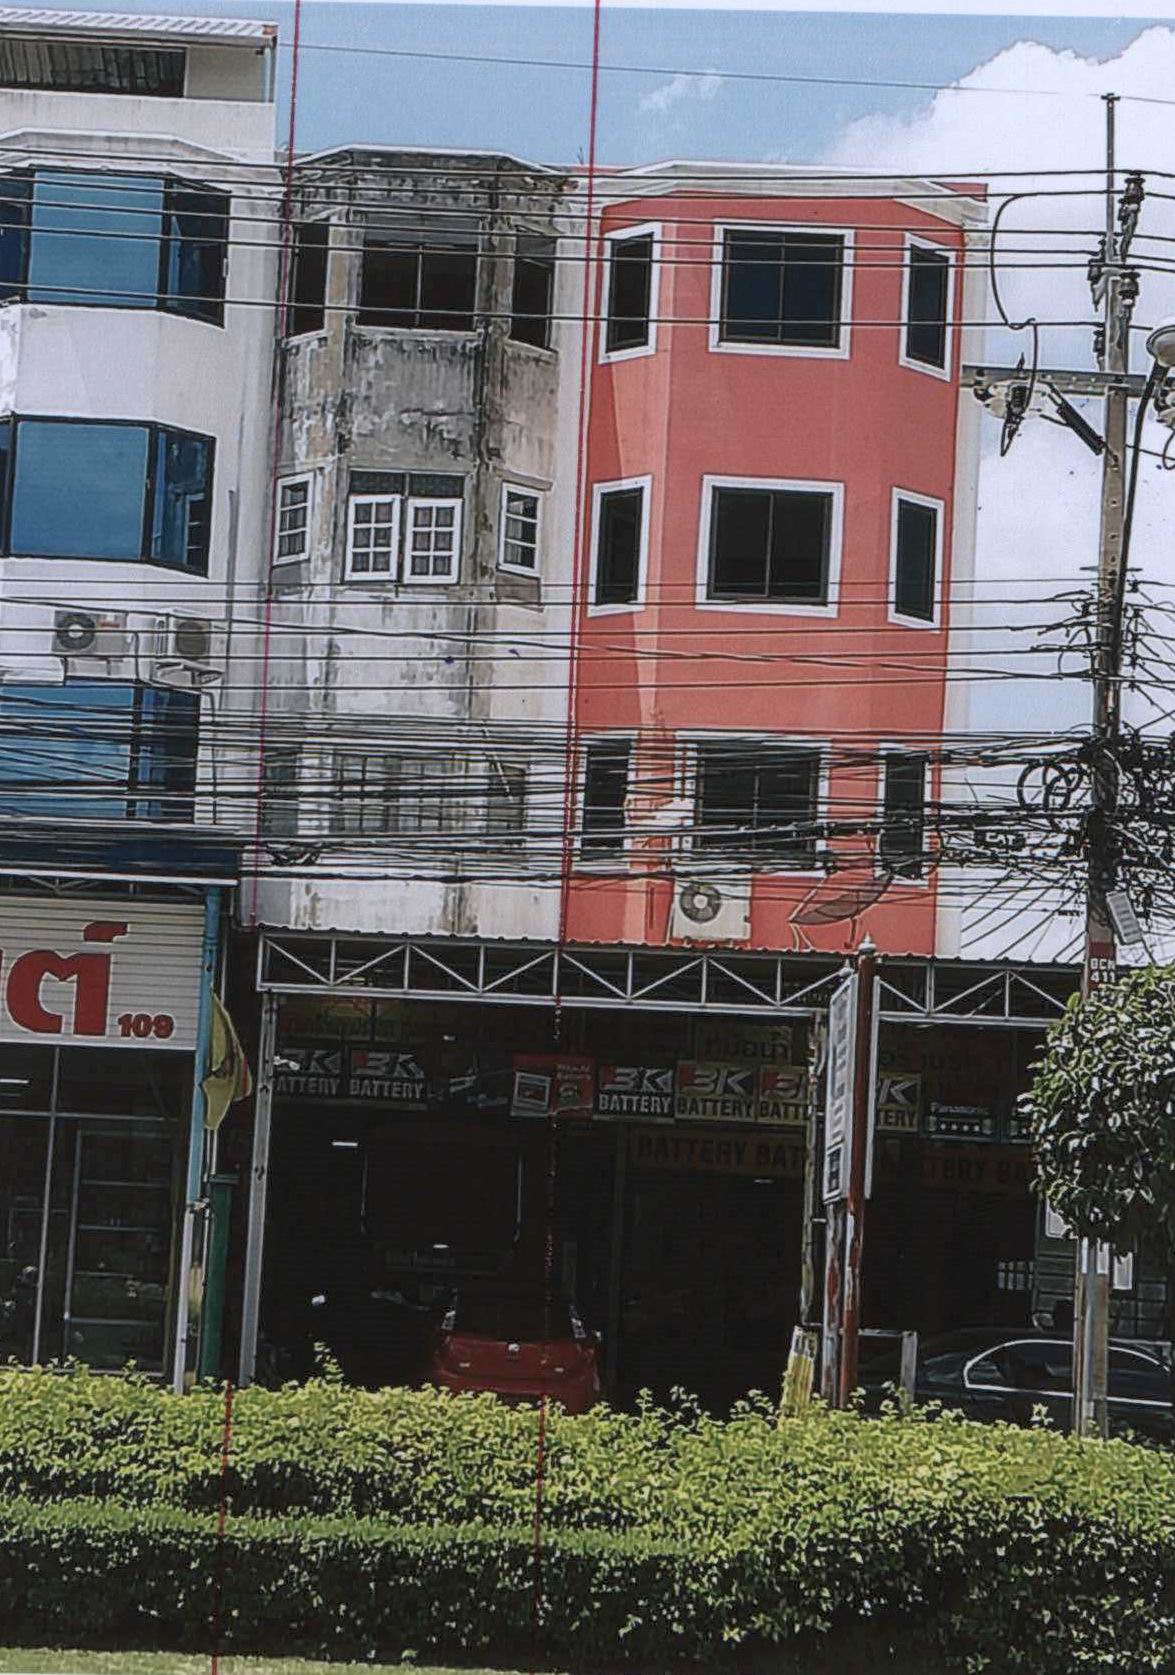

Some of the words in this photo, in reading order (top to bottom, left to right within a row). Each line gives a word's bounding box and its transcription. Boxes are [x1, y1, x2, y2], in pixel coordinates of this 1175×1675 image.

[1090, 970, 1116, 983] 411
[274, 1075, 341, 1097] ATTERY
[350, 1078, 424, 1099] BATTERY
[599, 1093, 672, 1115] BATTERY
[678, 1100, 752, 1120] BATTERY
